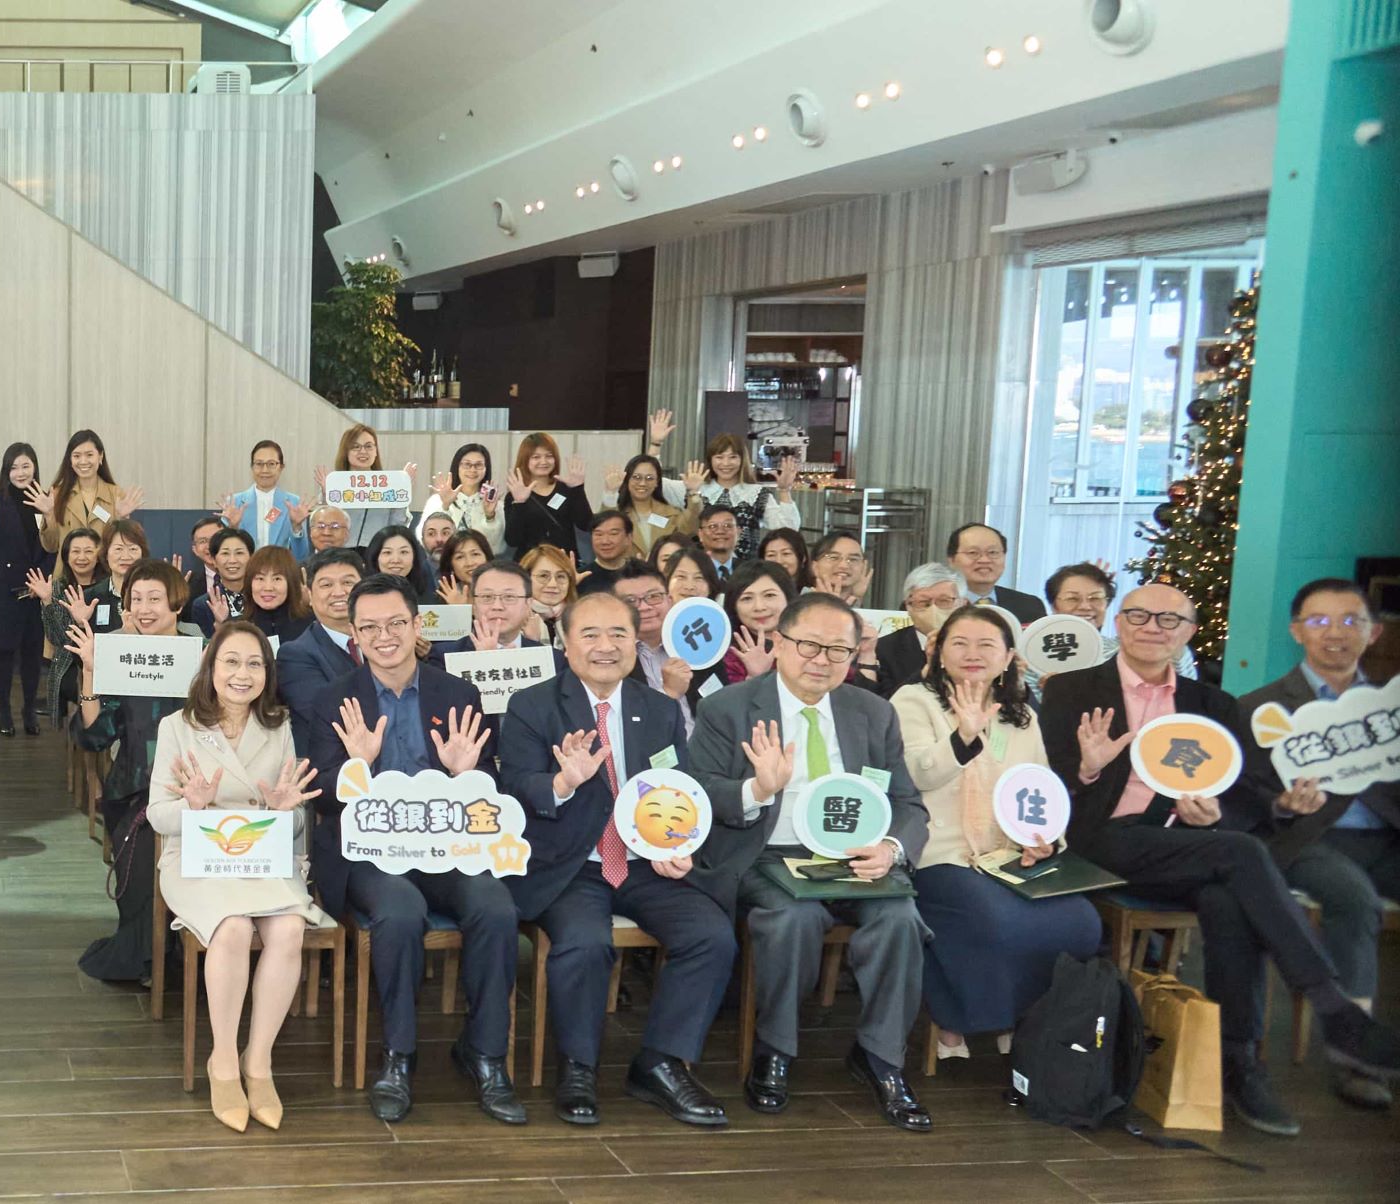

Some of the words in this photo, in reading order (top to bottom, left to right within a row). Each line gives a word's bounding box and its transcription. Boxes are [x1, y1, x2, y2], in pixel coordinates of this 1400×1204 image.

[350, 475, 388, 487] 12.12
[681, 617, 712, 651] 行
[1042, 633, 1079, 661] 學
[120, 653, 174, 666] 時尚生活
[129, 671, 164, 680] Lifestyle
[480, 687, 505, 696] riendly
[355, 798, 501, 834] 從銀到金
[823, 796, 862, 833] 醫
[1016, 787, 1047, 825] 住
[346, 842, 382, 856] From
[387, 845, 426, 858] Silver
[430, 846, 445, 857] to
[451, 842, 481, 857] Gold
